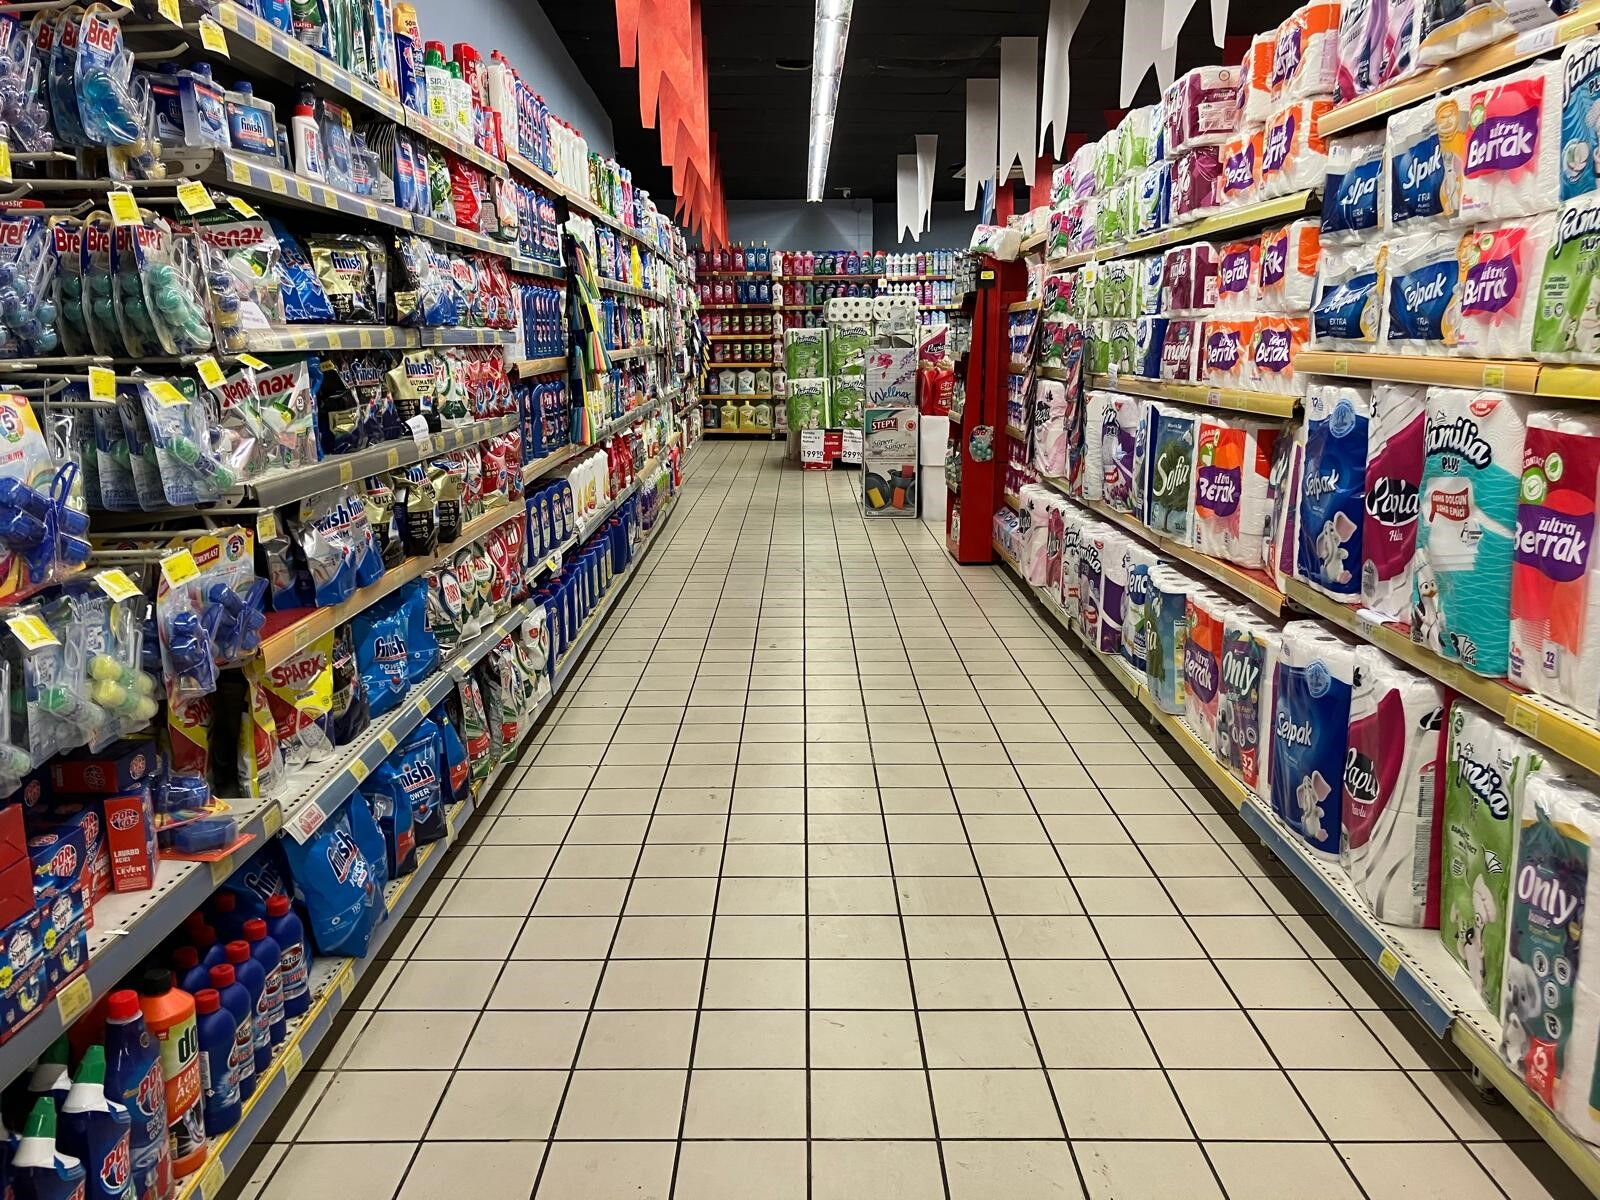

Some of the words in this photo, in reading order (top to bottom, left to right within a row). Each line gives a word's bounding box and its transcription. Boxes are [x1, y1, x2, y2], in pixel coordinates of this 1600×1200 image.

[87, 18, 118, 52] Bref
[240, 117, 263, 136] finish
[1467, 128, 1533, 169] Berrak
[0, 218, 29, 246] ref
[54, 225, 80, 253] Bre
[87, 226, 109, 252] Bre
[331, 252, 362, 271] finish
[1404, 272, 1447, 312] Selpak
[405, 356, 434, 375] finish
[259, 373, 295, 397] nax
[869, 385, 911, 404] Wellnax
[2, 413, 15, 431] 5
[872, 419, 896, 430] STEPY
[1425, 415, 1492, 470] familia
[1153, 453, 1189, 498] Sofia
[1442, 457, 1459, 473] PLUS
[1538, 517, 1576, 535] ultra
[231, 541, 239, 553] 5
[374, 634, 408, 658] finish
[1546, 651, 1555, 664] 12
[271, 656, 327, 688] SPARK
[1185, 649, 1212, 692] Berrak
[1223, 651, 1258, 697] Only
[1277, 711, 1312, 748] Selpak
[1241, 753, 1253, 770] 32
[400, 760, 434, 789] nish
[410, 788, 430, 801] OWER
[116, 865, 146, 875] LEVENT
[1518, 865, 1578, 925] Only
[178, 1024, 198, 1064] do
